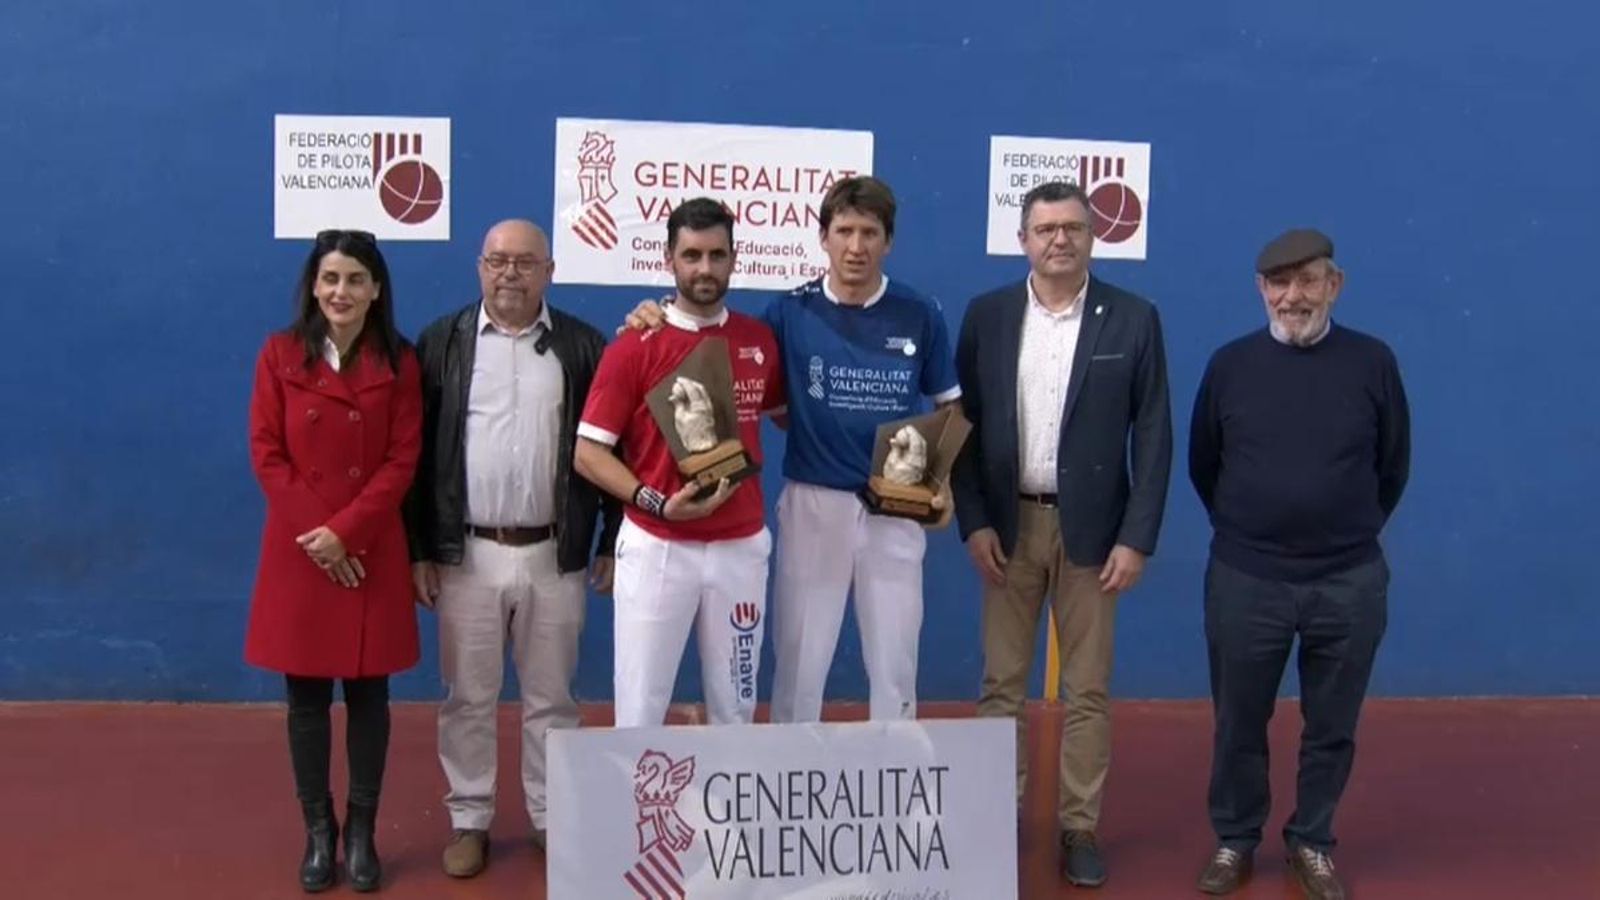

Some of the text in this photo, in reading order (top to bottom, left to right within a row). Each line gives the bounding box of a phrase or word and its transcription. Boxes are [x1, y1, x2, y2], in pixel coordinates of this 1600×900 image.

[288, 132, 372, 148] FEDERACIÓ
[297, 154, 371, 169] DE PILOTA
[281, 174, 372, 189] VALENCIANA
[1010, 174, 1028, 188] DE
[791, 262, 795, 276] i
[829, 366, 912, 382] GENERALITAT
[830, 379, 910, 394] VALENCIANA
[738, 633, 755, 699] Enave
[703, 766, 950, 824] GENERALITAT
[704, 820, 950, 880] VALENCIANA
